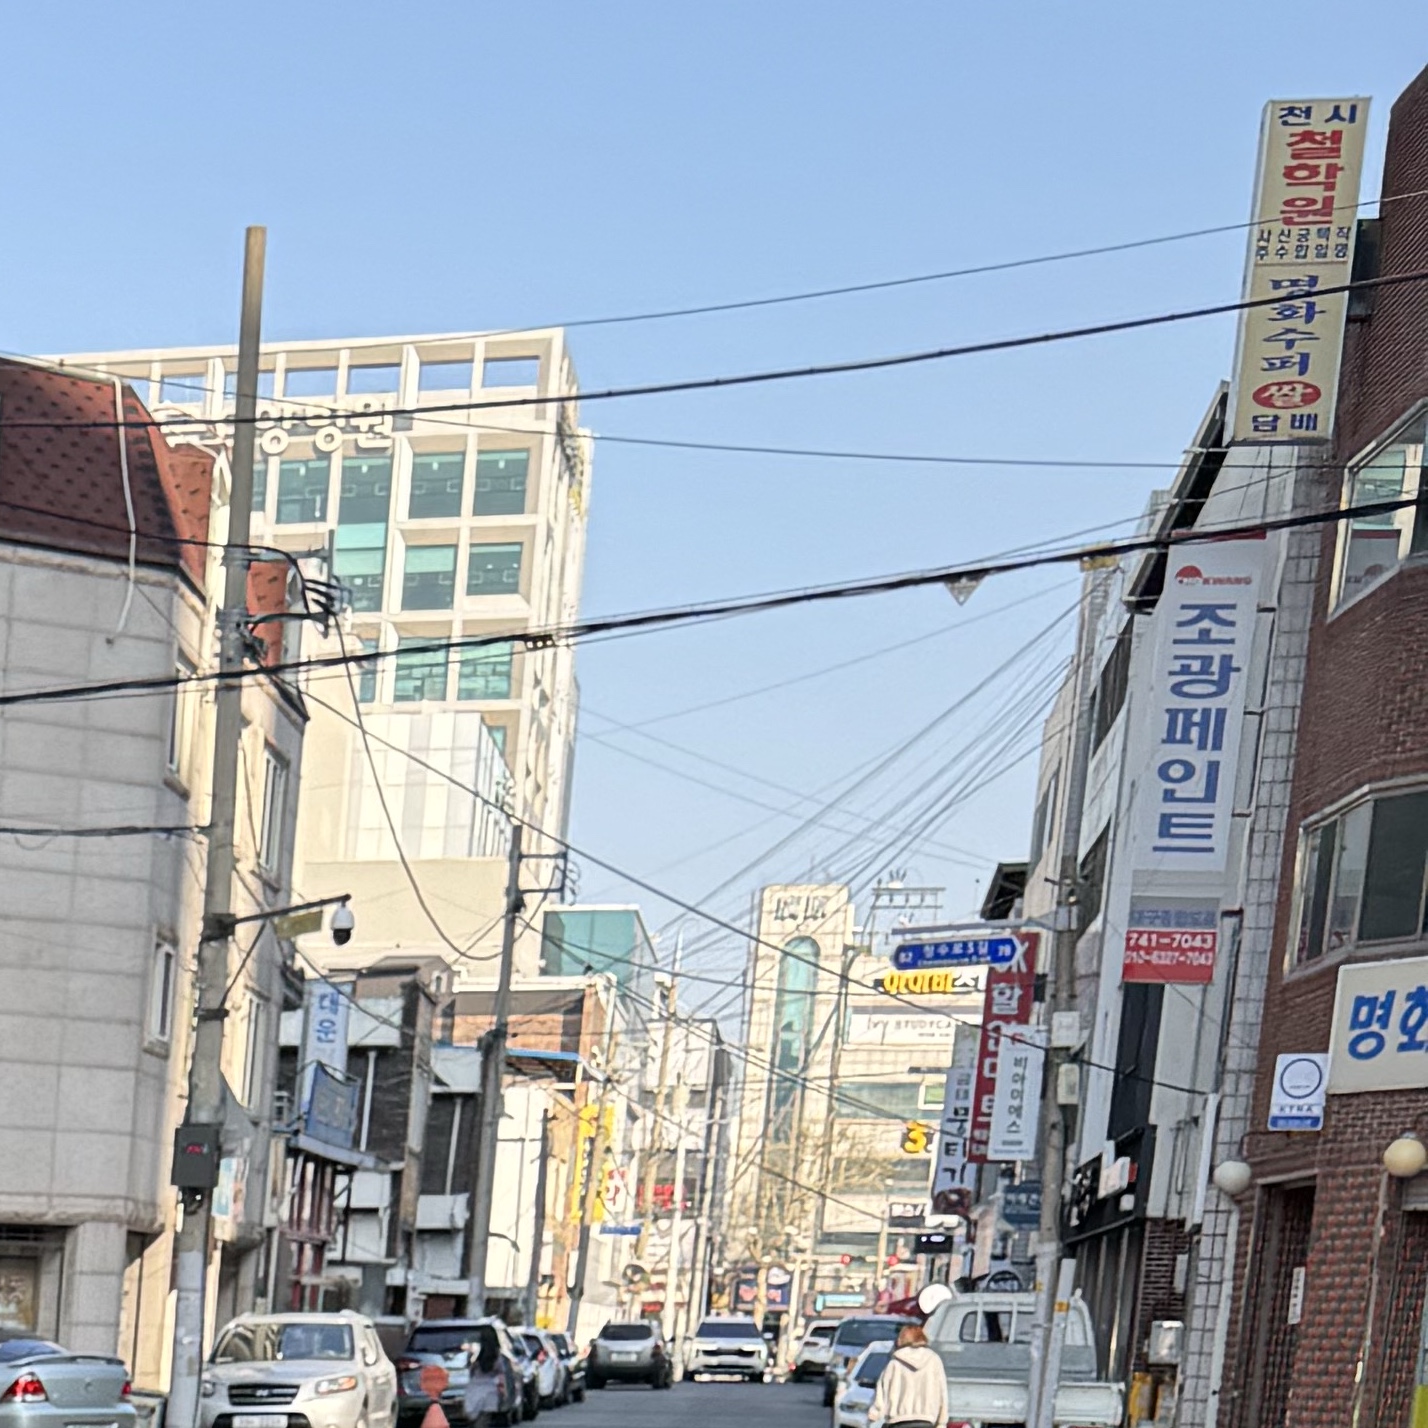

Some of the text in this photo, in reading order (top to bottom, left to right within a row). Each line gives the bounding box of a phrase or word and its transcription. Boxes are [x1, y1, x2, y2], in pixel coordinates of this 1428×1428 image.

[1280, 130, 1345, 226] 철학원
[1260, 275, 1326, 376] 명화수퍼
[1252, 413, 1318, 432] 담배
[1152, 603, 1242, 853] 조광페인트
[1128, 933, 1214, 949] 741-7043
